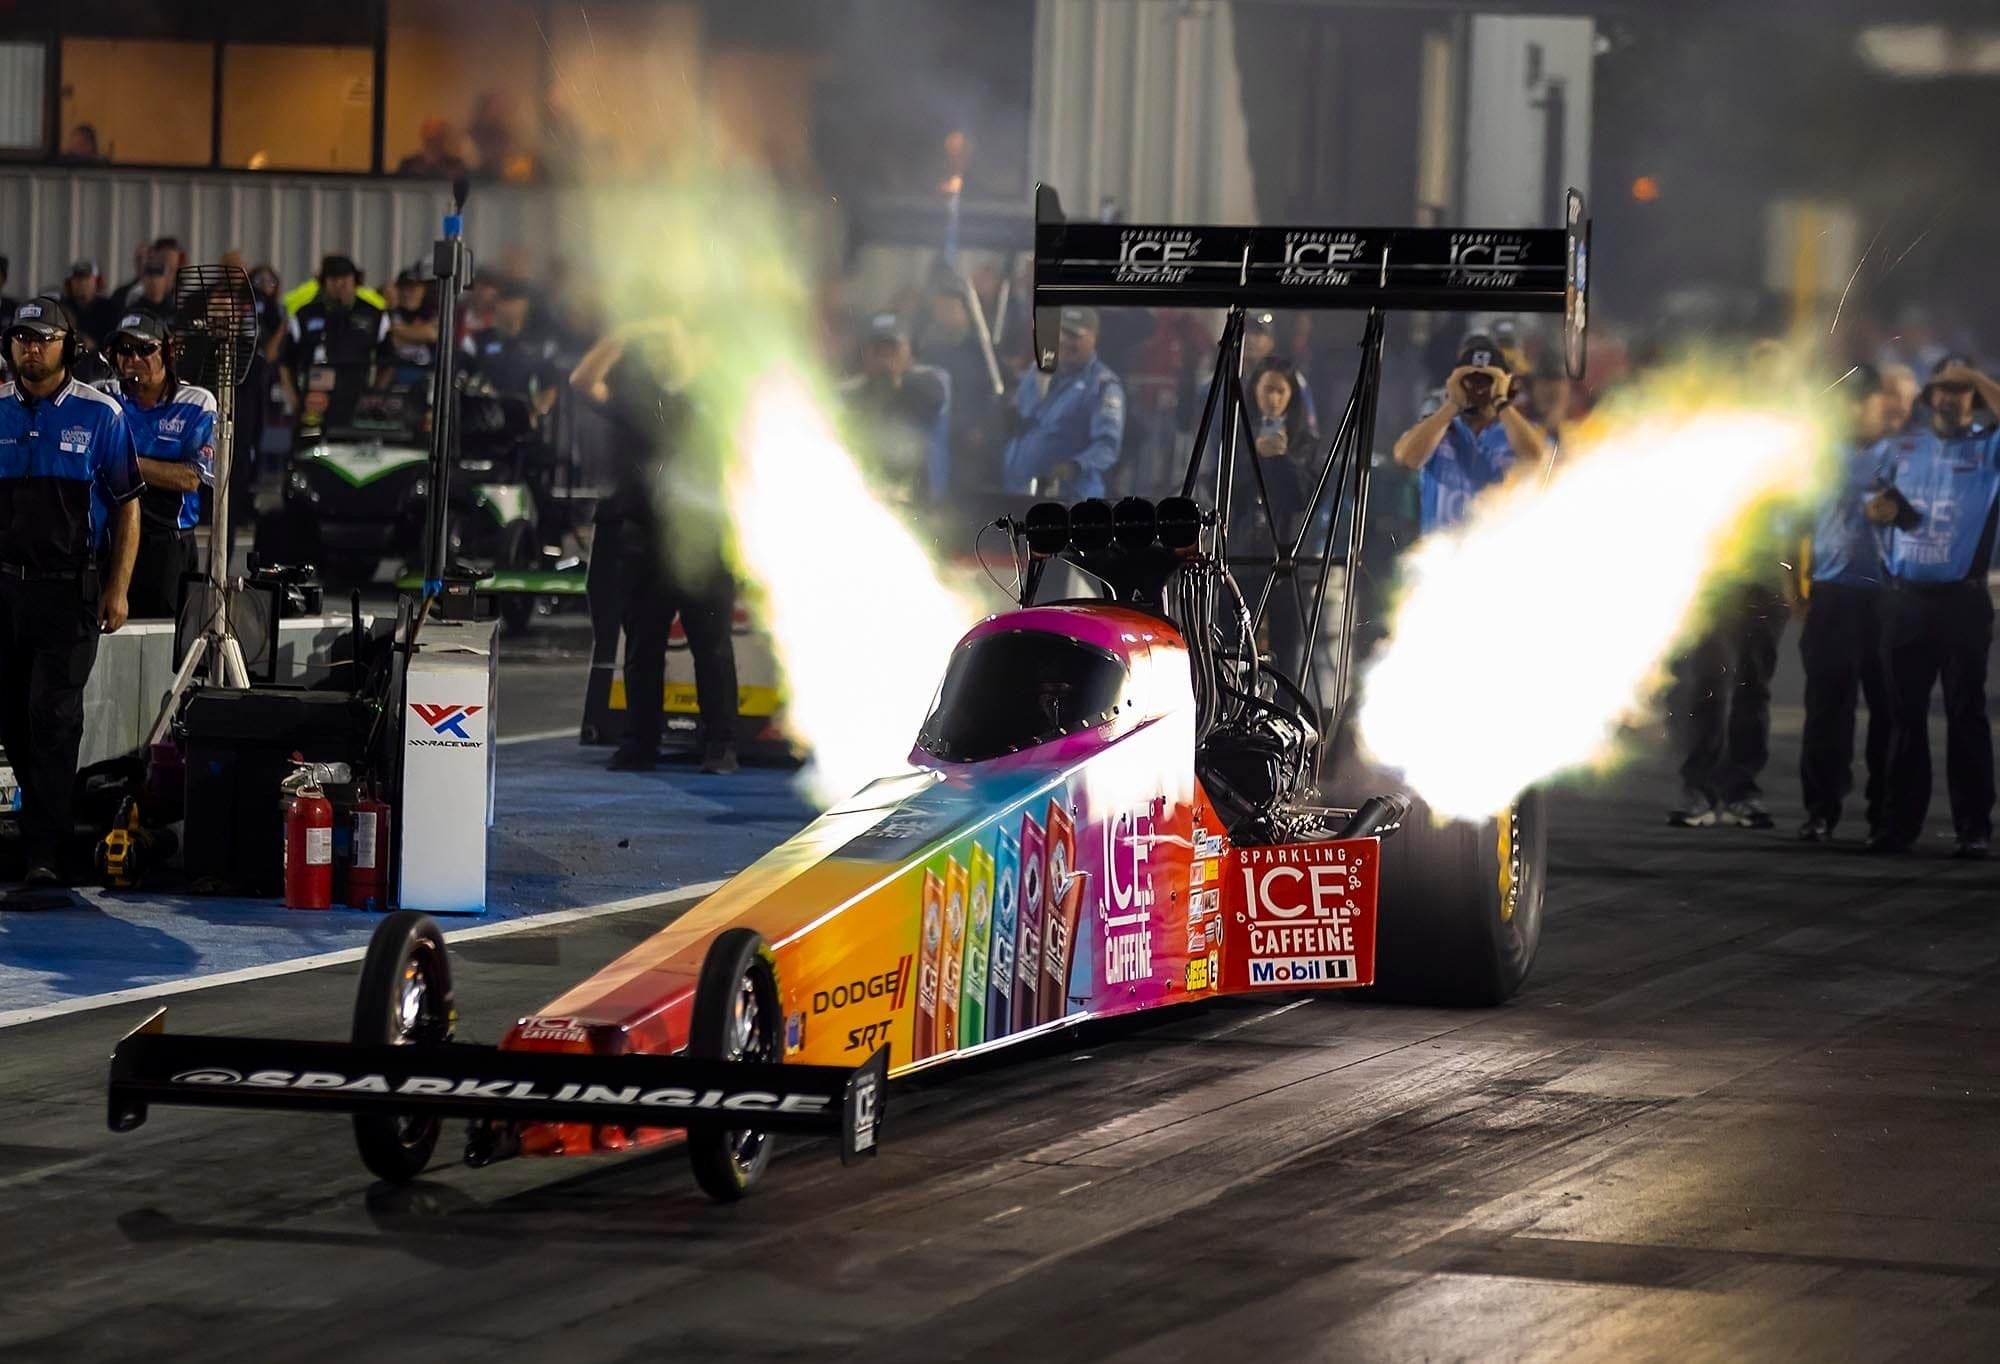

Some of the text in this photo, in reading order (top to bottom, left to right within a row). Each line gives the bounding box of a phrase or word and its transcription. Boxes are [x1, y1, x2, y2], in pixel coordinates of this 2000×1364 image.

[1119, 240, 1191, 273] ICE
[1284, 243, 1356, 276] ICE
[1450, 244, 1521, 276] ICE
[428, 740, 483, 748] RACEWAY
[1102, 802, 1151, 911] ICE
[1240, 848, 1346, 864] SPARKLING
[1242, 865, 1351, 919] ICE
[1250, 926, 1354, 955] CAFFEINE
[1105, 930, 1153, 985] CAFFEINE
[1252, 959, 1320, 982] Mobil
[813, 969, 900, 1015] DODGE
[521, 1029, 586, 1042] CAFFEINE
[844, 1019, 893, 1053] SRT
